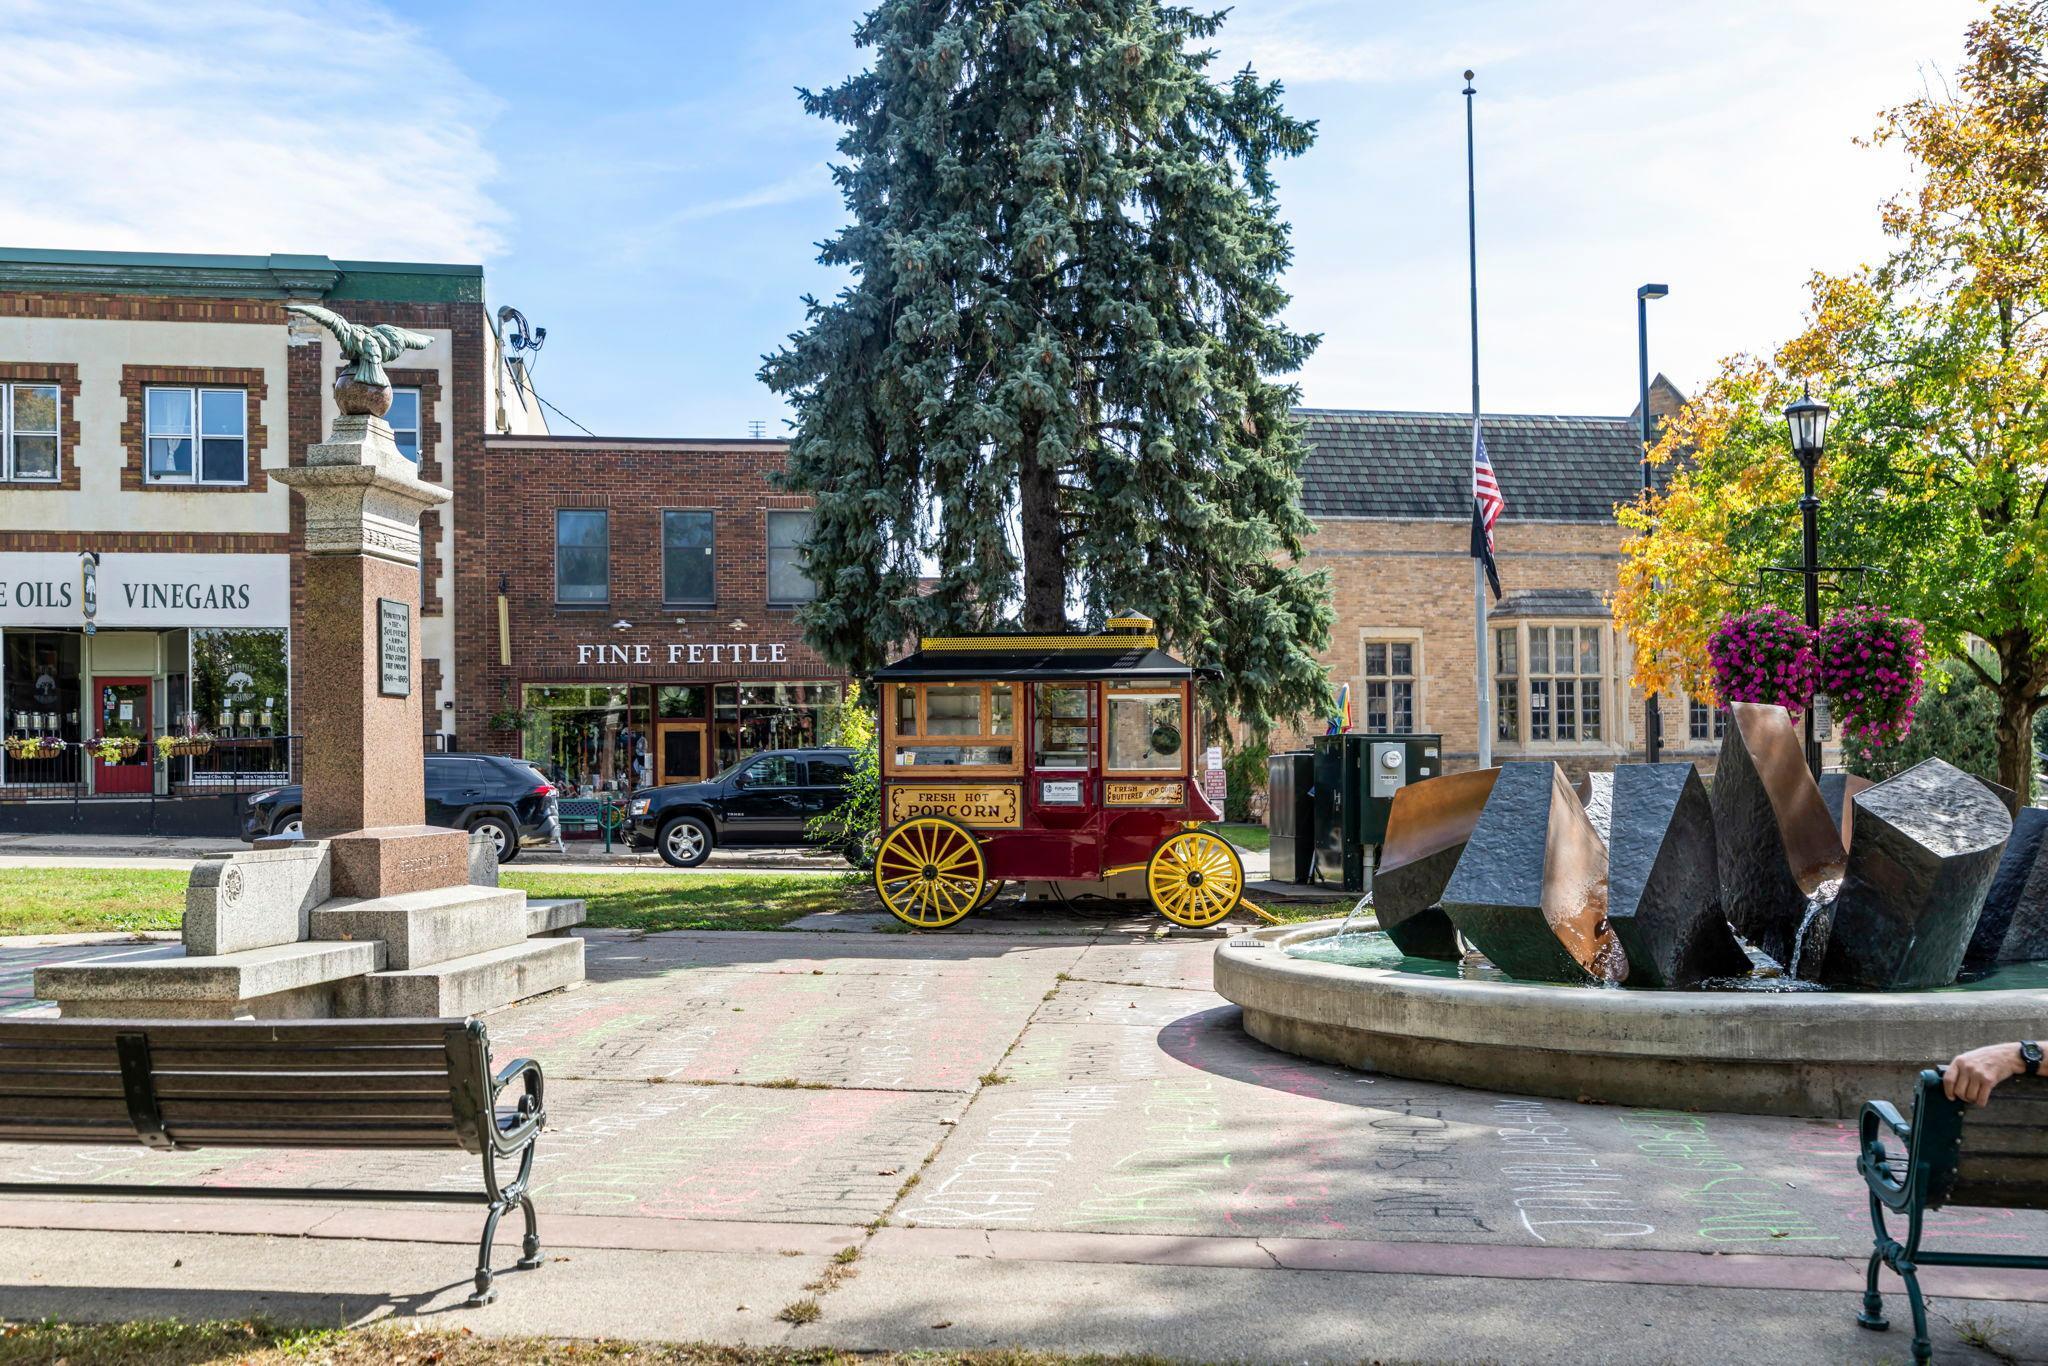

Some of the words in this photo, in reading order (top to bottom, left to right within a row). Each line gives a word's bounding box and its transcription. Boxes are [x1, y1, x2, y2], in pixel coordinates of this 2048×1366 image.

[15, 581, 72, 608] OILS
[122, 583, 250, 610] VINEGARS
[384, 626, 406, 638] SOLDIERS
[385, 643, 406, 654] SAILORS
[576, 644, 651, 664] FINE
[667, 643, 787, 664] FETTLE
[918, 793, 956, 802] FRESH
[965, 793, 989, 802] HOT
[1112, 792, 1143, 800] BUTTERED
[1146, 787, 1159, 797] POP
[907, 805, 1000, 817] POPCORN
[1501, 1159, 1653, 1241] JAMAL
[1670, 1176, 1842, 1241] ANAS
